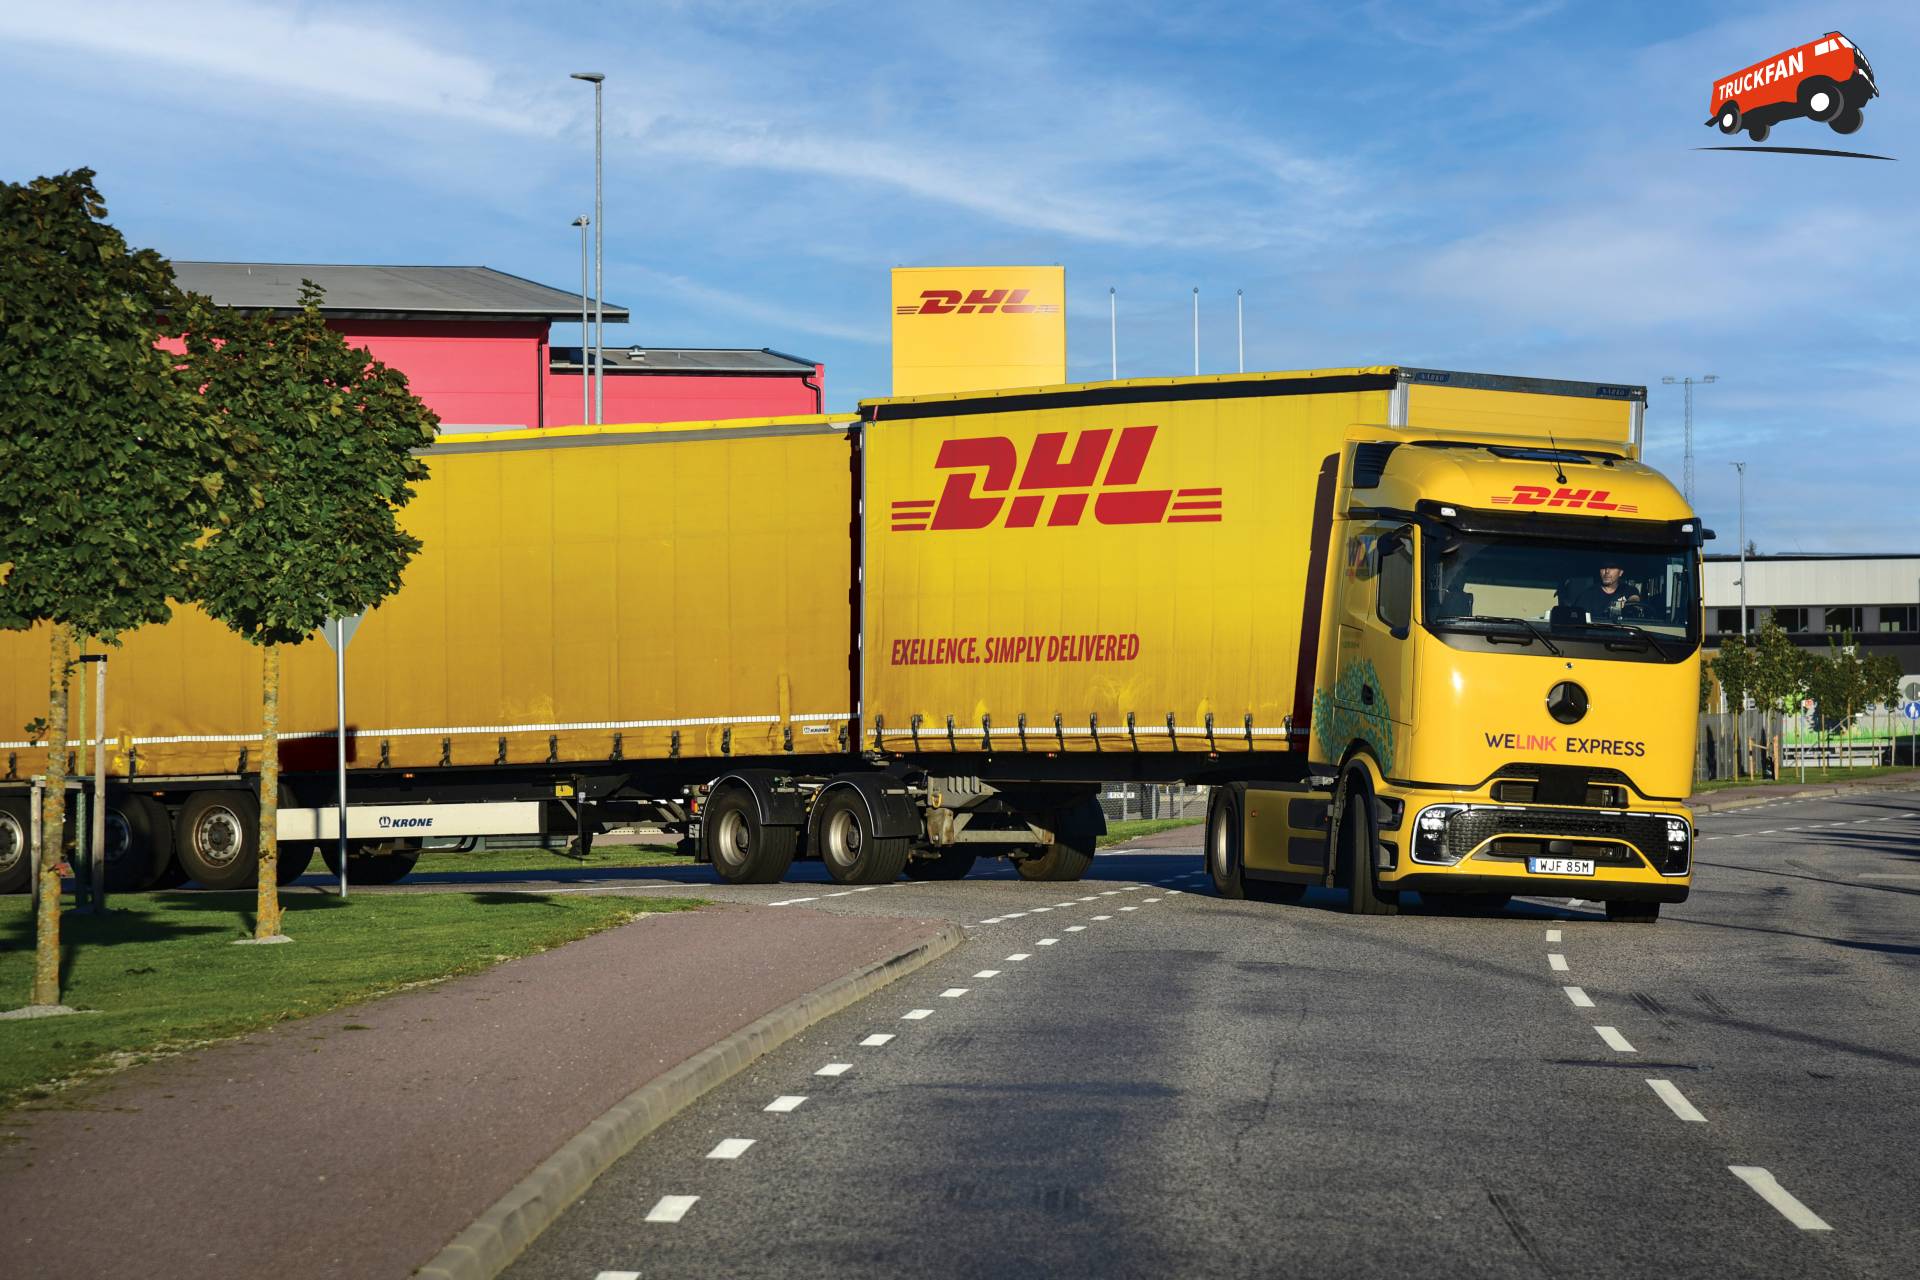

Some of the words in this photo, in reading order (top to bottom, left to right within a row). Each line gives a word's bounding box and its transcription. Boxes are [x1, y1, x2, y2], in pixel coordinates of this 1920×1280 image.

[918, 289, 1037, 315] DHL
[930, 425, 1173, 531] DHL
[1511, 485, 1620, 512] DHL
[891, 637, 980, 666] EXELLENCE.
[983, 635, 1046, 664] SIMPLY
[1046, 633, 1140, 663] DELIVERED
[1485, 732, 1557, 752] WELINK
[1566, 737, 1646, 757] EXPRESS
[392, 817, 434, 828] KRONE
[1540, 859, 1562, 872] WJF
[1566, 861, 1589, 873] 85M
